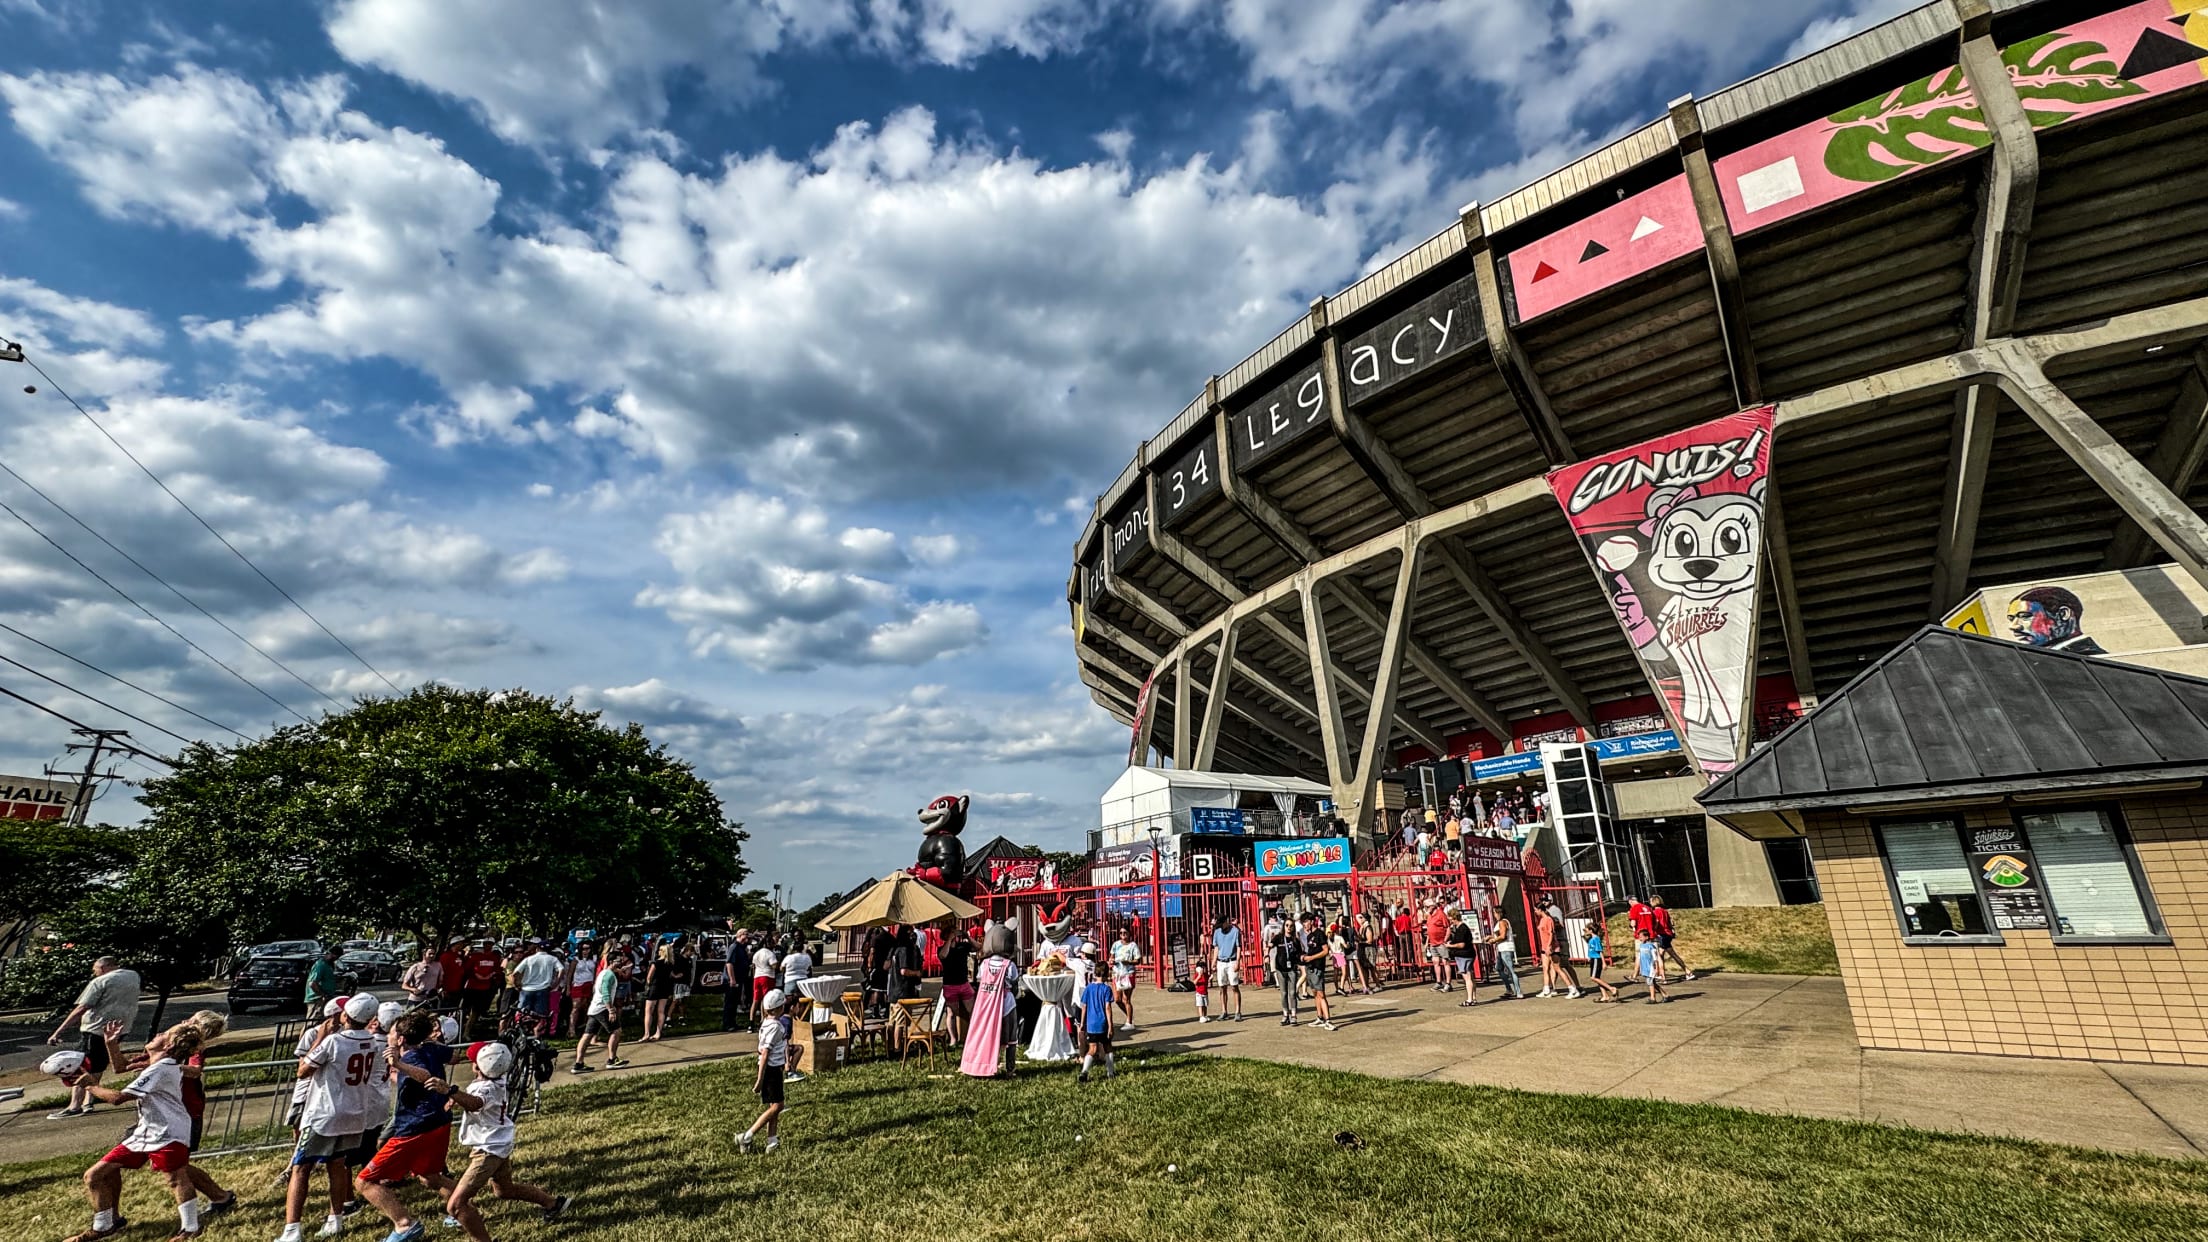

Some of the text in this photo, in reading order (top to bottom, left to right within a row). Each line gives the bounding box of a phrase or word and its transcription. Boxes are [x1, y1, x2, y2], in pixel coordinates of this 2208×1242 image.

[1172, 449, 1209, 510] 34
[1666, 612, 1729, 649] SQUIRRELS
[1659, 735, 1674, 743] Area
[0, 785, 67, 804] HAUL
[1480, 847, 1504, 858] SEASON
[1974, 843, 2021, 852] TICKETS
[1196, 858, 1211, 876] B
[1468, 857, 1520, 870] TICKET HOLDERS
